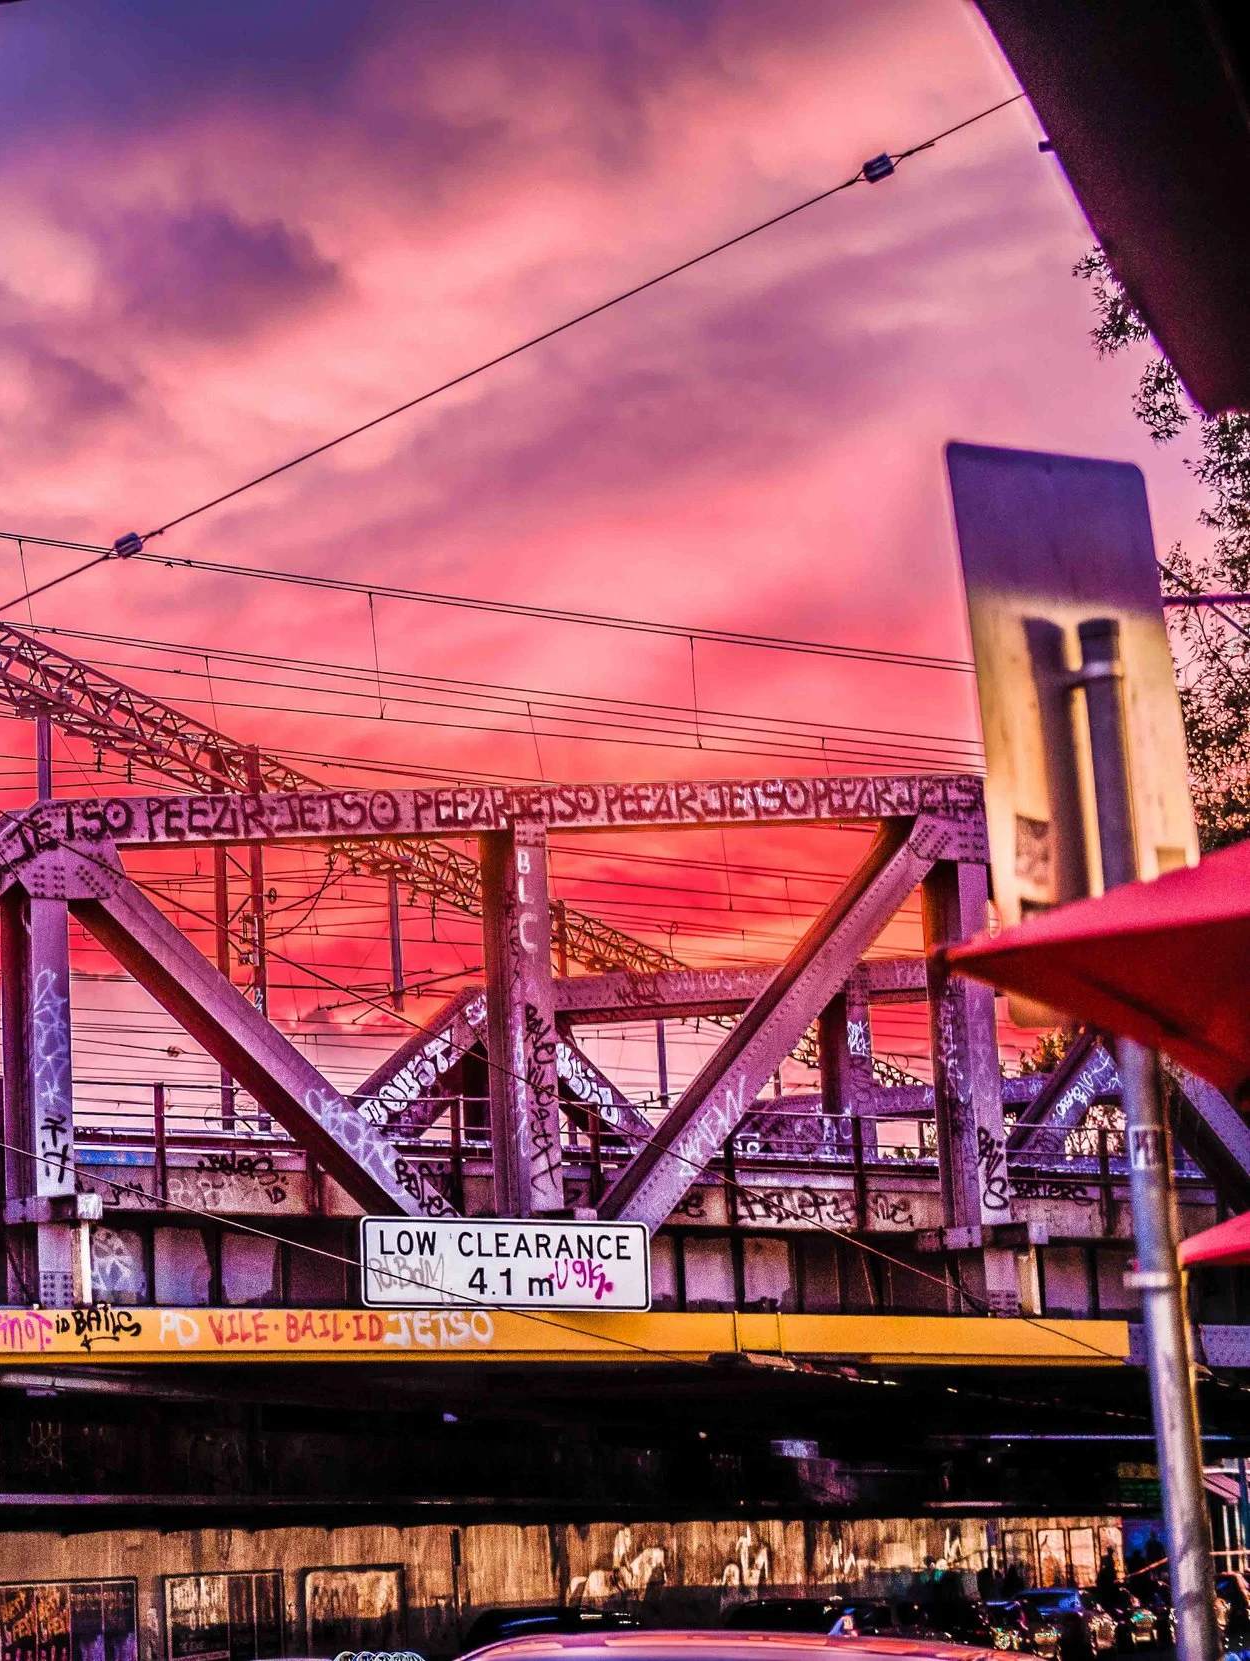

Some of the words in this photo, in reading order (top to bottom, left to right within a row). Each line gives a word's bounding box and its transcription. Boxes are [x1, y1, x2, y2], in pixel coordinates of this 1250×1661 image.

[379, 1230, 437, 1256] LOW
[458, 1231, 631, 1260] CLEARANCE
[468, 1267, 513, 1296] 4.1
[528, 1276, 554, 1297] m
[383, 1310, 495, 1348] JETSO
